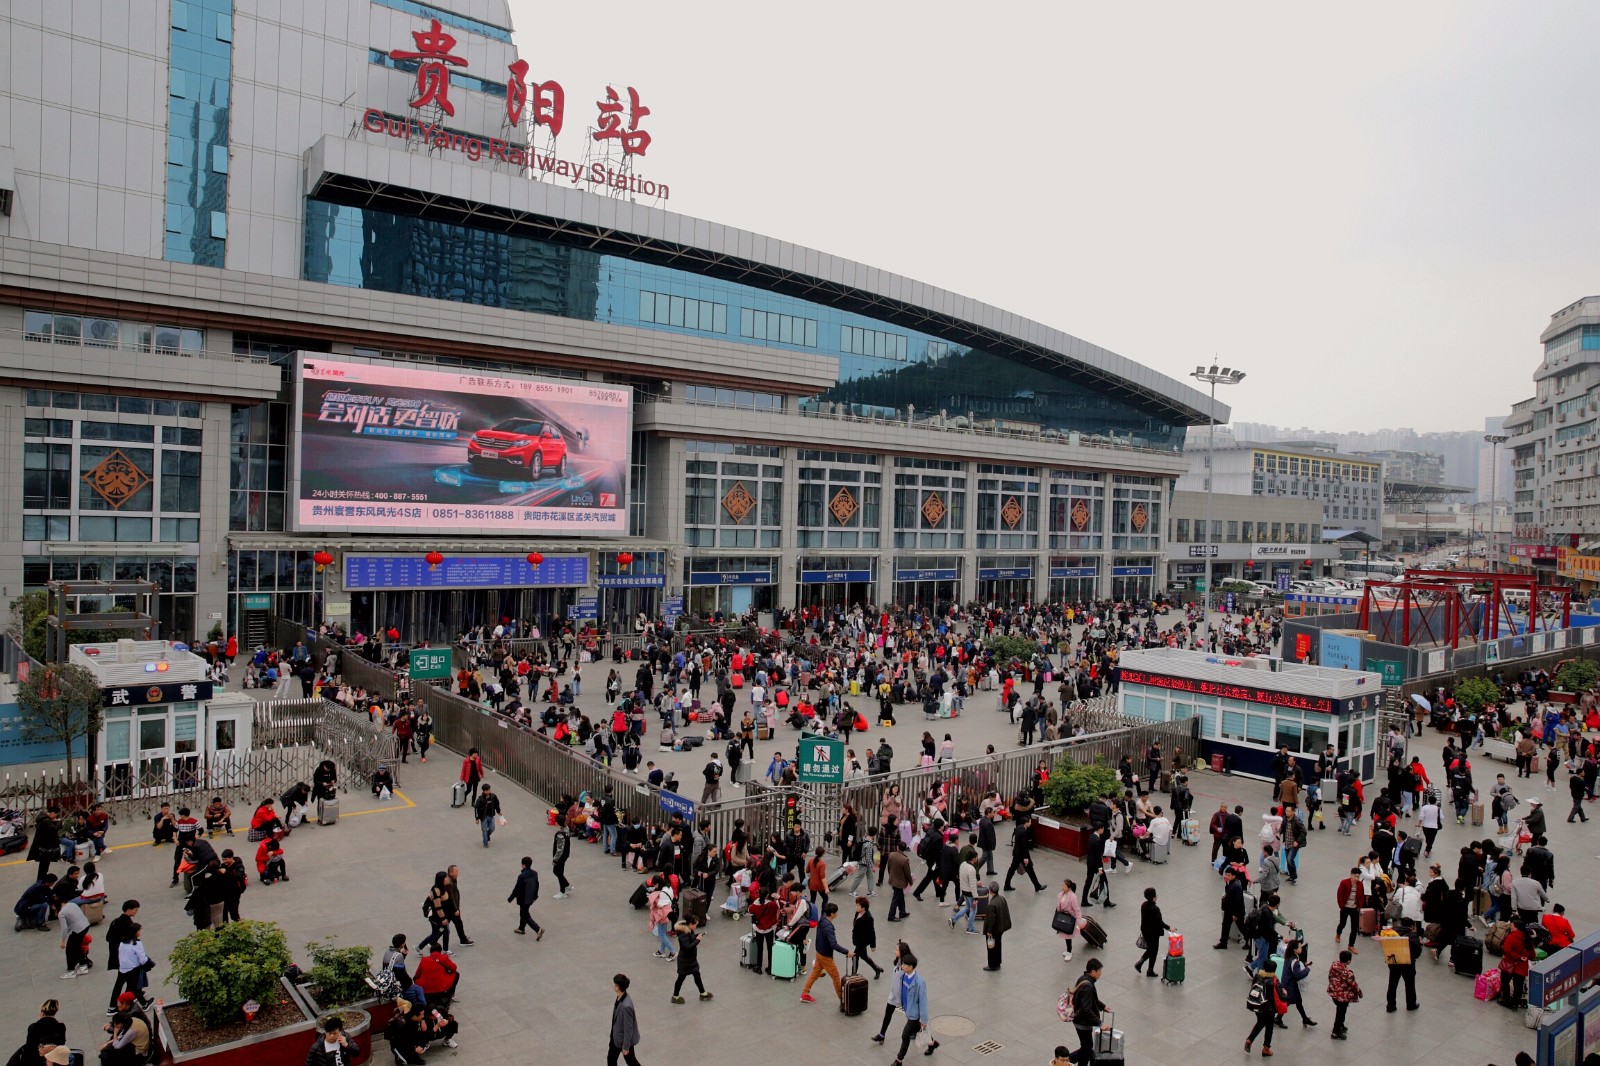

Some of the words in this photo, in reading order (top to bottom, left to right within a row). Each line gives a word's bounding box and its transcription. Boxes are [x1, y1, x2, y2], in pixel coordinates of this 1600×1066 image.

[389, 18, 652, 157] 贵阳站
[363, 108, 411, 139] Gui
[416, 119, 482, 162] Yang
[489, 137, 584, 184] Railway
[590, 162, 670, 200] Station
[536, 385, 553, 393] 8555
[318, 402, 392, 434] 会对话
[432, 508, 514, 520] 0851-83611888
[181, 685, 198, 700] 警
[803, 763, 840, 774] 请勿通过
